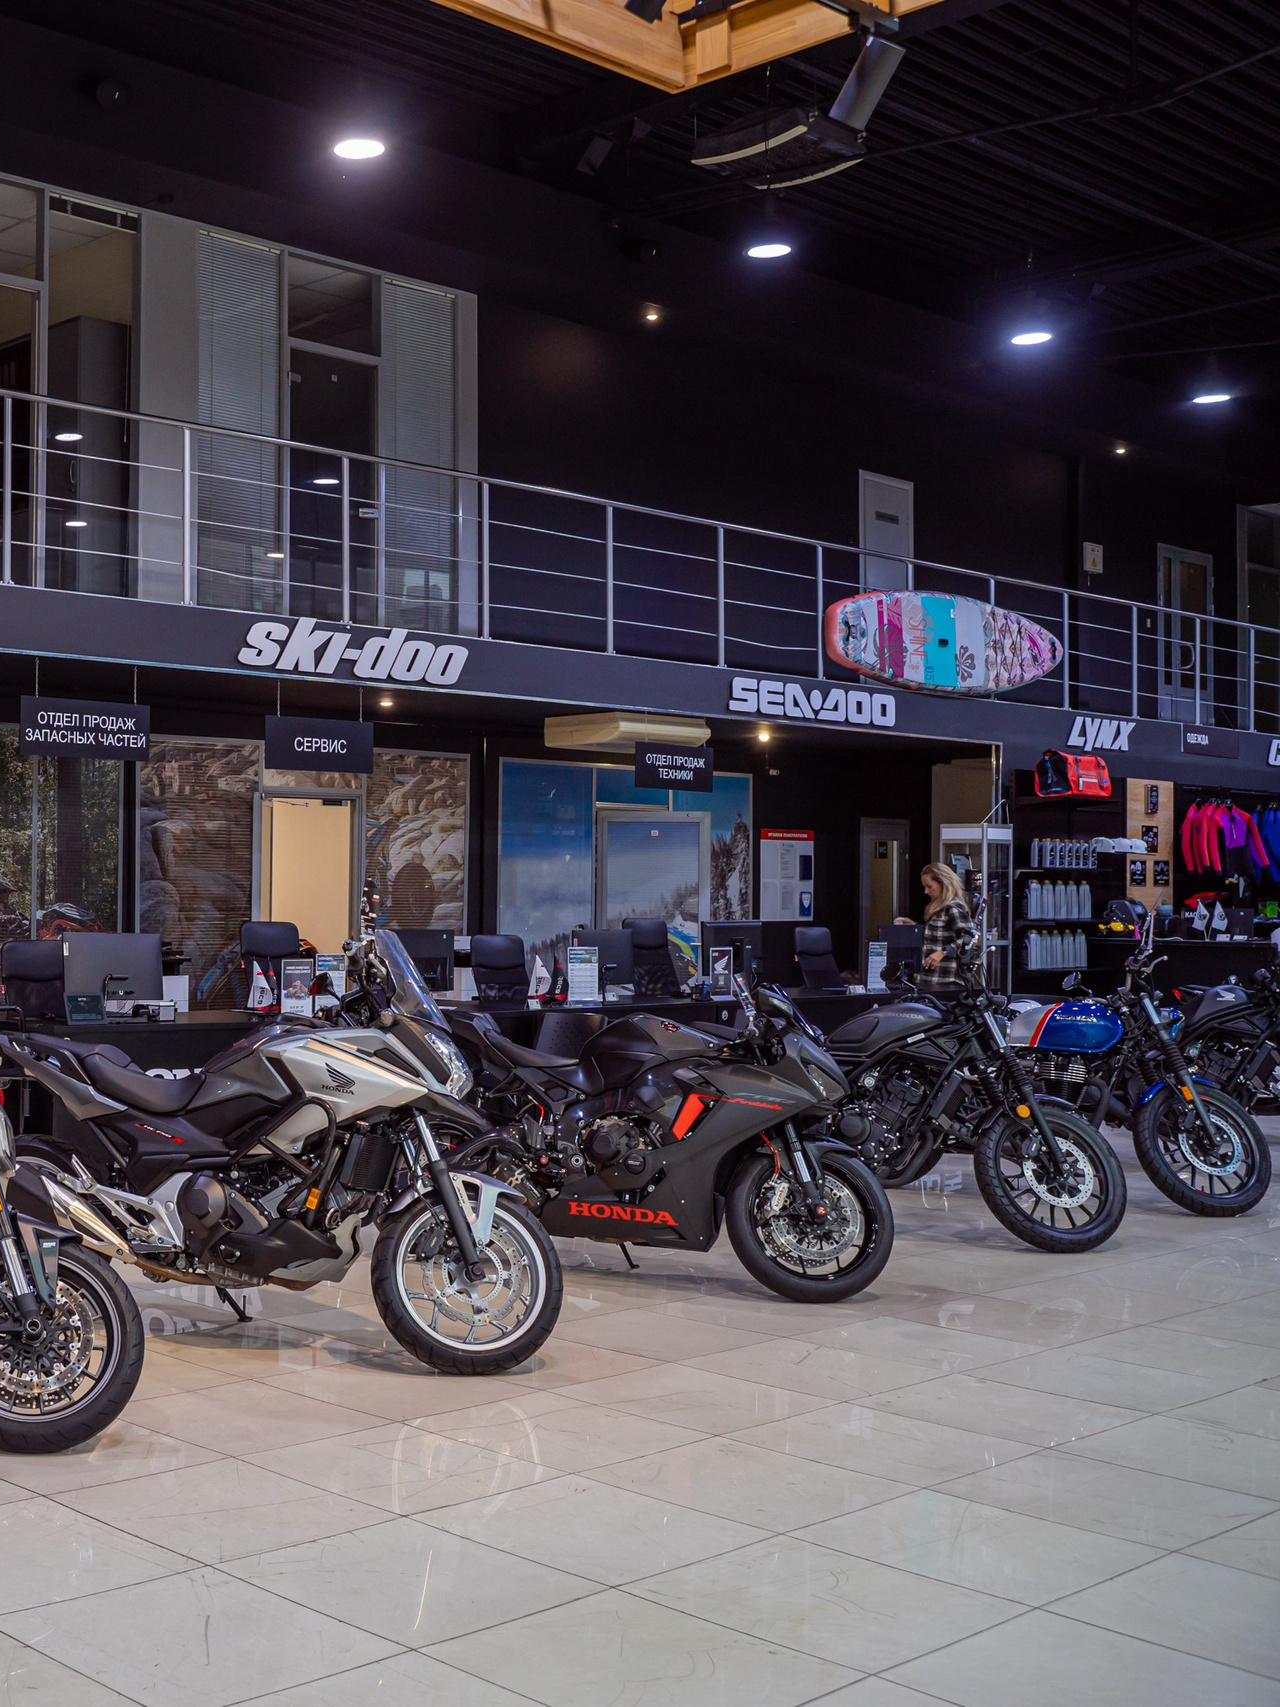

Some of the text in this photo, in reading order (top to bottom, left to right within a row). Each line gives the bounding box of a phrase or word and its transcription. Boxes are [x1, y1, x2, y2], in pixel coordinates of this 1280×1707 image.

[237, 616, 469, 686] ski-doo
[37, 711, 136, 734] ОТДЕЛ ПРОДАЖ
[24, 727, 147, 749] ЗАПАСНЫХ ЧАСТЕЙ
[1067, 716, 1136, 752] LYNX
[1186, 732, 1209, 745] ОДЕЖДА
[293, 737, 348, 755] СЕРВИС
[645, 753, 706, 770] ОТДЕЛ ПРОДАЖ
[658, 768, 694, 781] ТЕХНИКИ
[887, 1012, 925, 1021] HONDA
[321, 1084, 355, 1096] HONDA
[568, 1202, 679, 1227] HONDA
